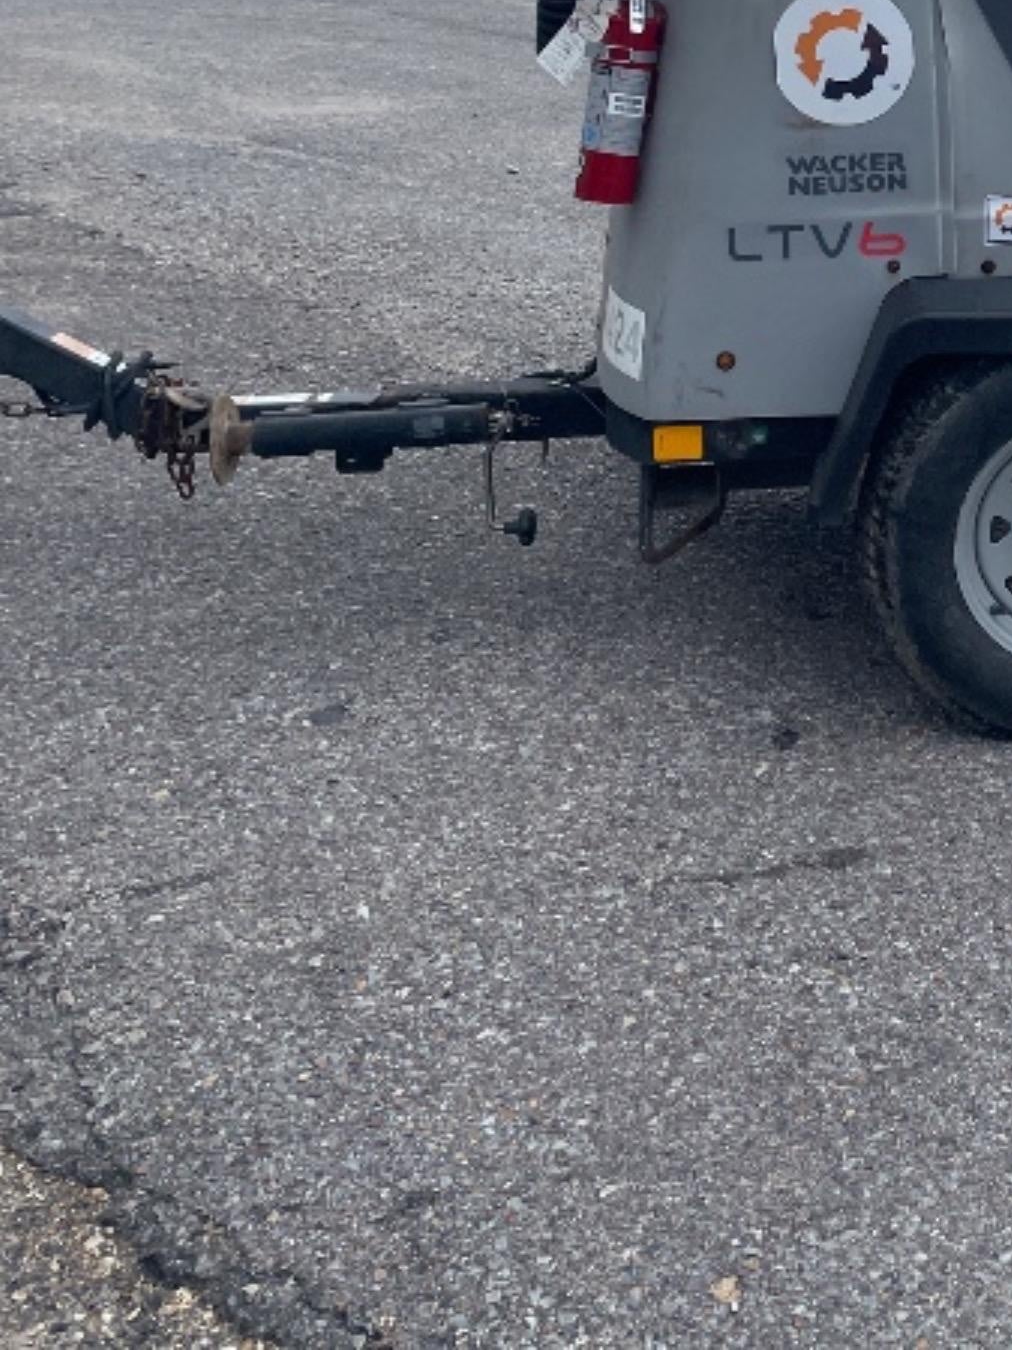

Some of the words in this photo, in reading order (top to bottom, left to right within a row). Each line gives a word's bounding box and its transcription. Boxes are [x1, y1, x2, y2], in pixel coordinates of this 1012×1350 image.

[785, 152, 907, 175] WACKER
[787, 172, 907, 195] NEUSON
[727, 221, 907, 262] LTV6
